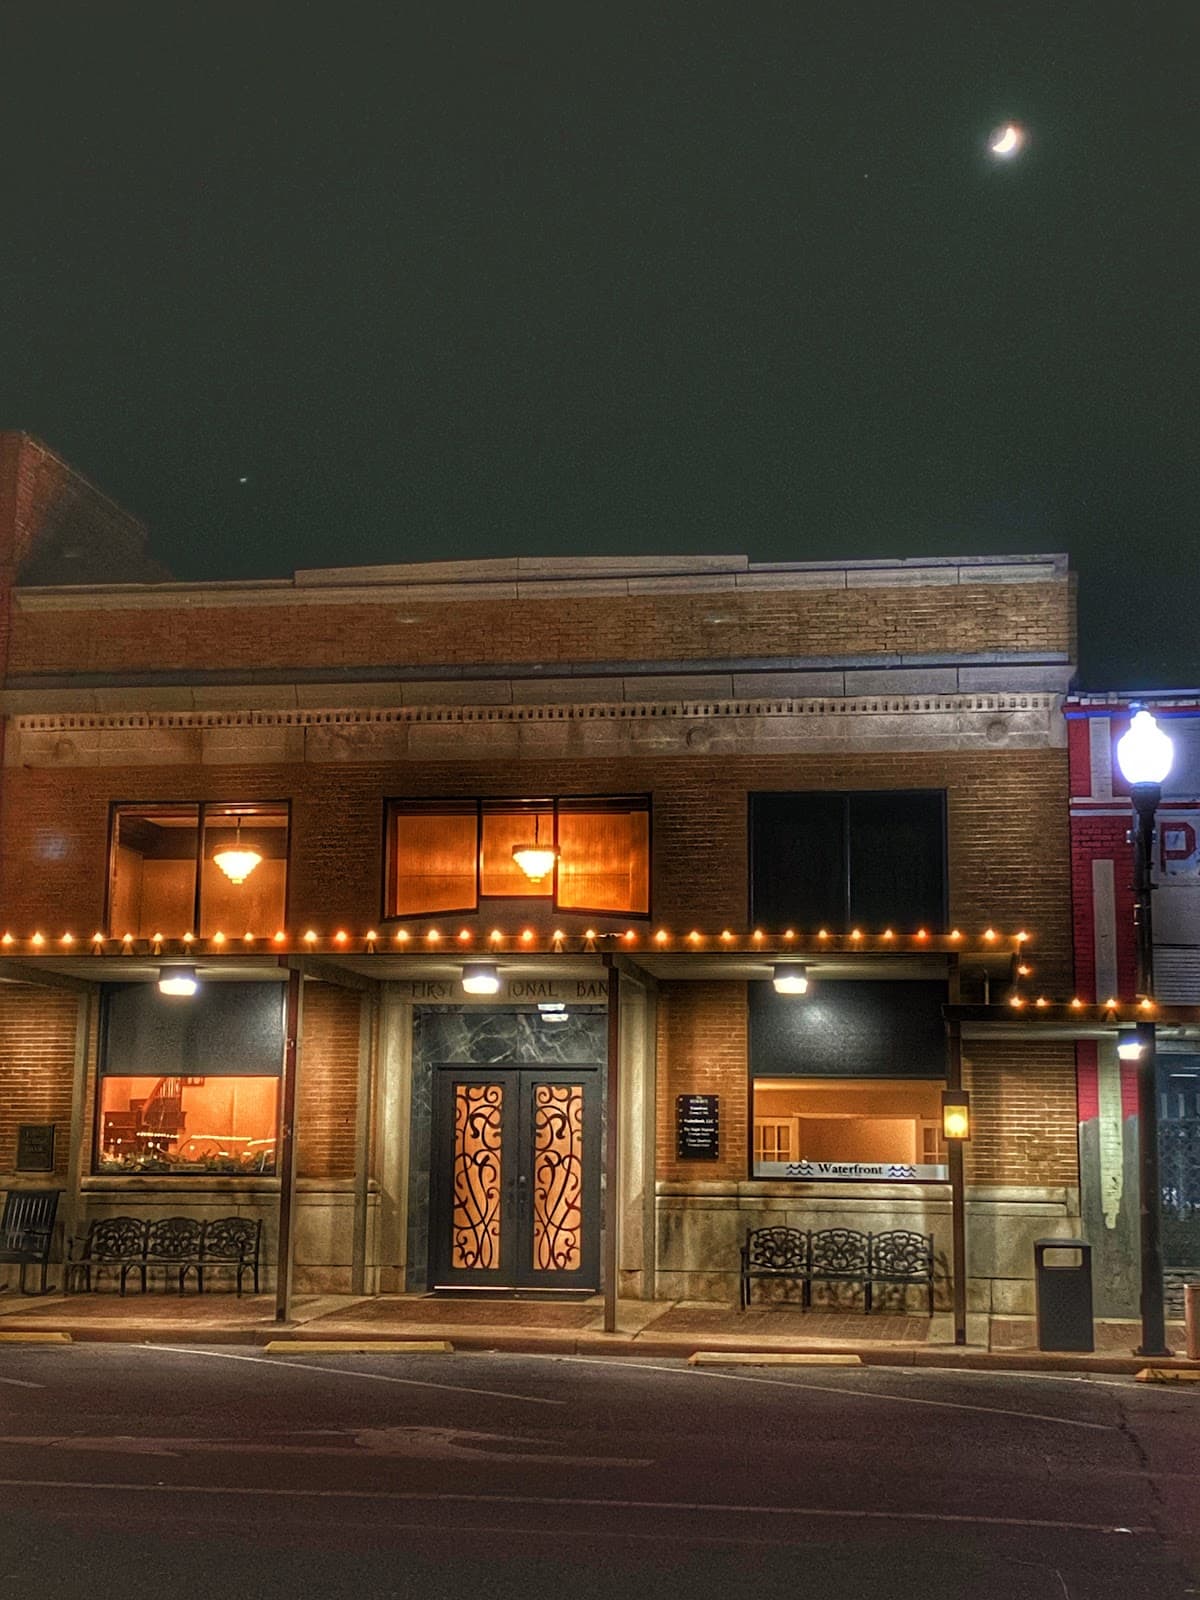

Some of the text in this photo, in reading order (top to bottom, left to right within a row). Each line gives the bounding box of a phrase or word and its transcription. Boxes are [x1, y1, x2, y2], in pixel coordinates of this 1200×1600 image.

[1160, 822, 1196, 872] P
[411, 980, 609, 999] FIRST IONAL BAN
[818, 1163, 882, 1175] Waterfront
